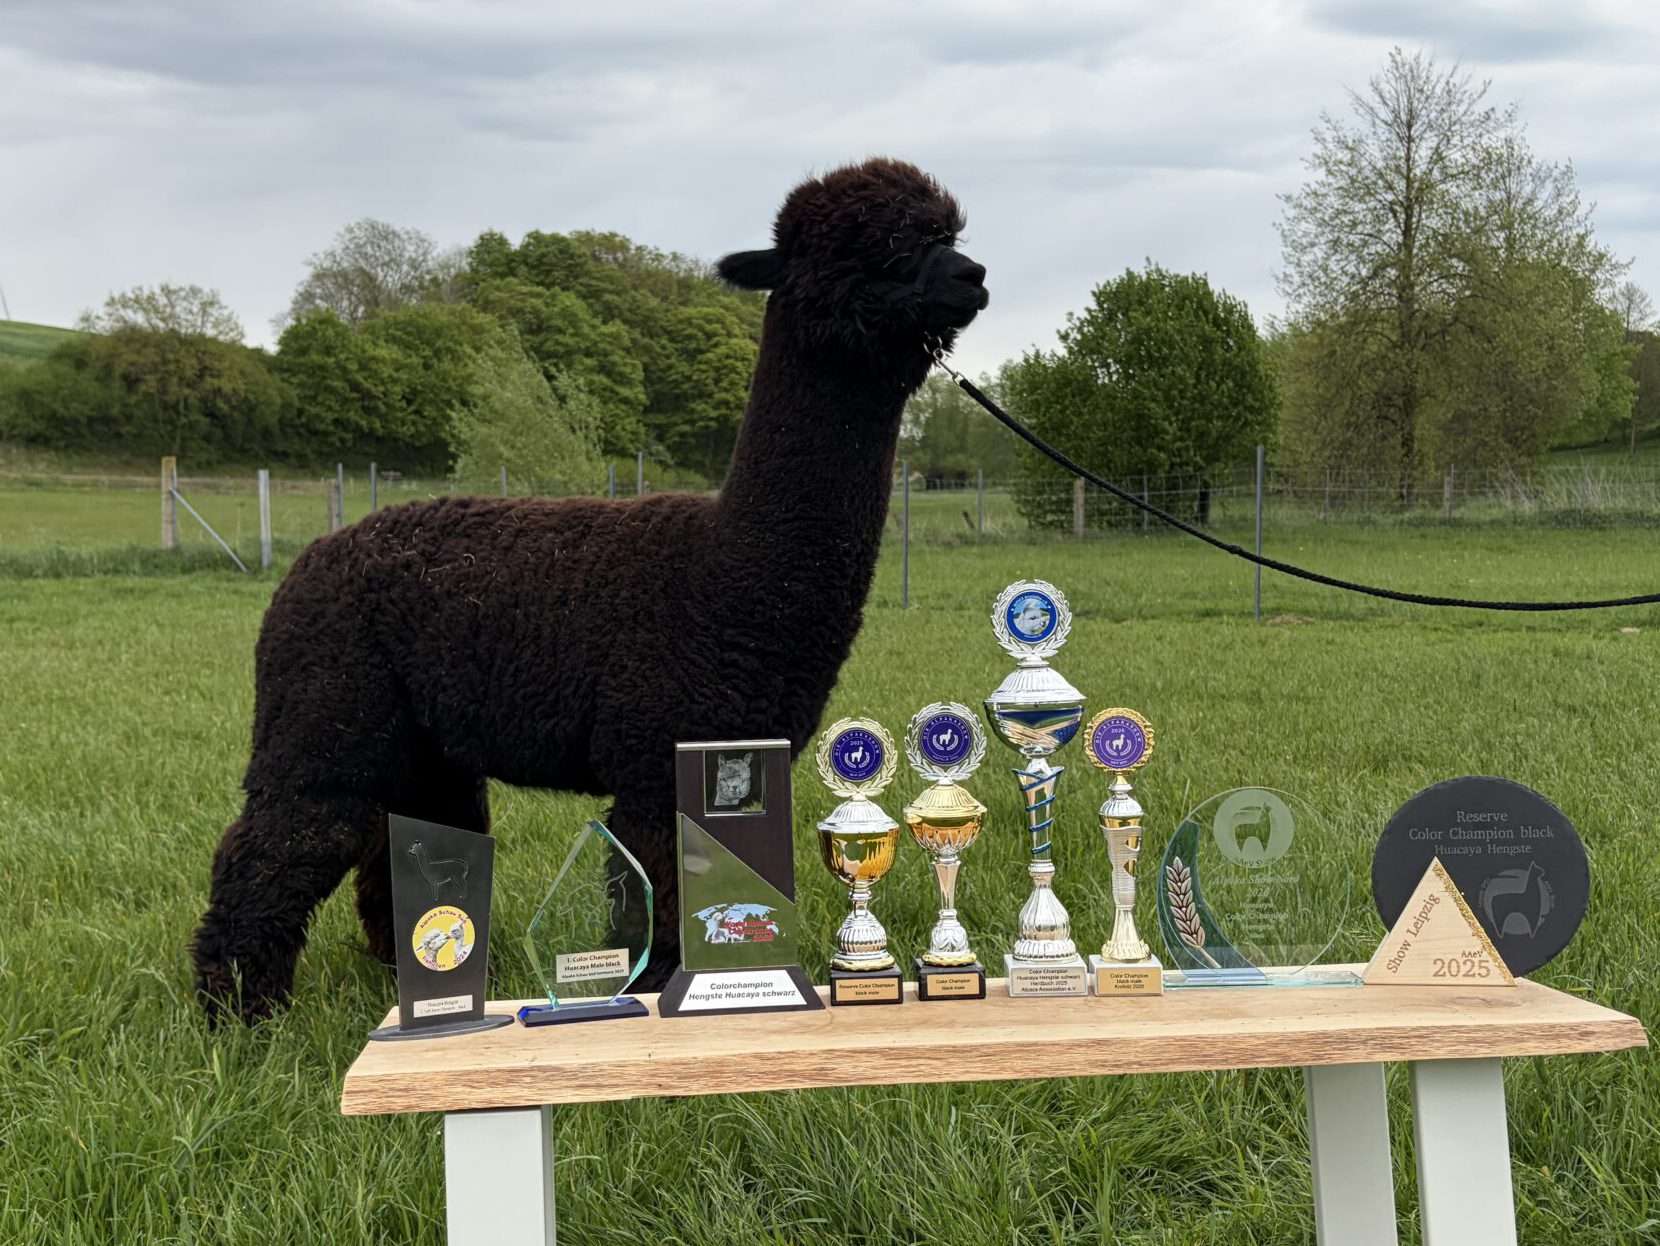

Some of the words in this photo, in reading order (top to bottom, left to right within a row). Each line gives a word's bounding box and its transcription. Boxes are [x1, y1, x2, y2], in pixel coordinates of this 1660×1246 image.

[1456, 810, 1508, 823] Reserve
[1408, 828, 1442, 841] Color
[1449, 826, 1514, 842] Champion
[1520, 825, 1554, 838] black
[1434, 844, 1482, 857] Huacaya
[1487, 844, 1532, 856] Hengste
[1386, 938, 1412, 974] Show
[1408, 893, 1441, 939] Leipzig
[589, 953, 620, 961] Champion
[1432, 958, 1491, 978] 2025
[710, 981, 773, 991] Colorchampion
[688, 992, 723, 1001] Hengste
[725, 991, 760, 1000] Huacaya
[762, 990, 796, 998] schwarz
